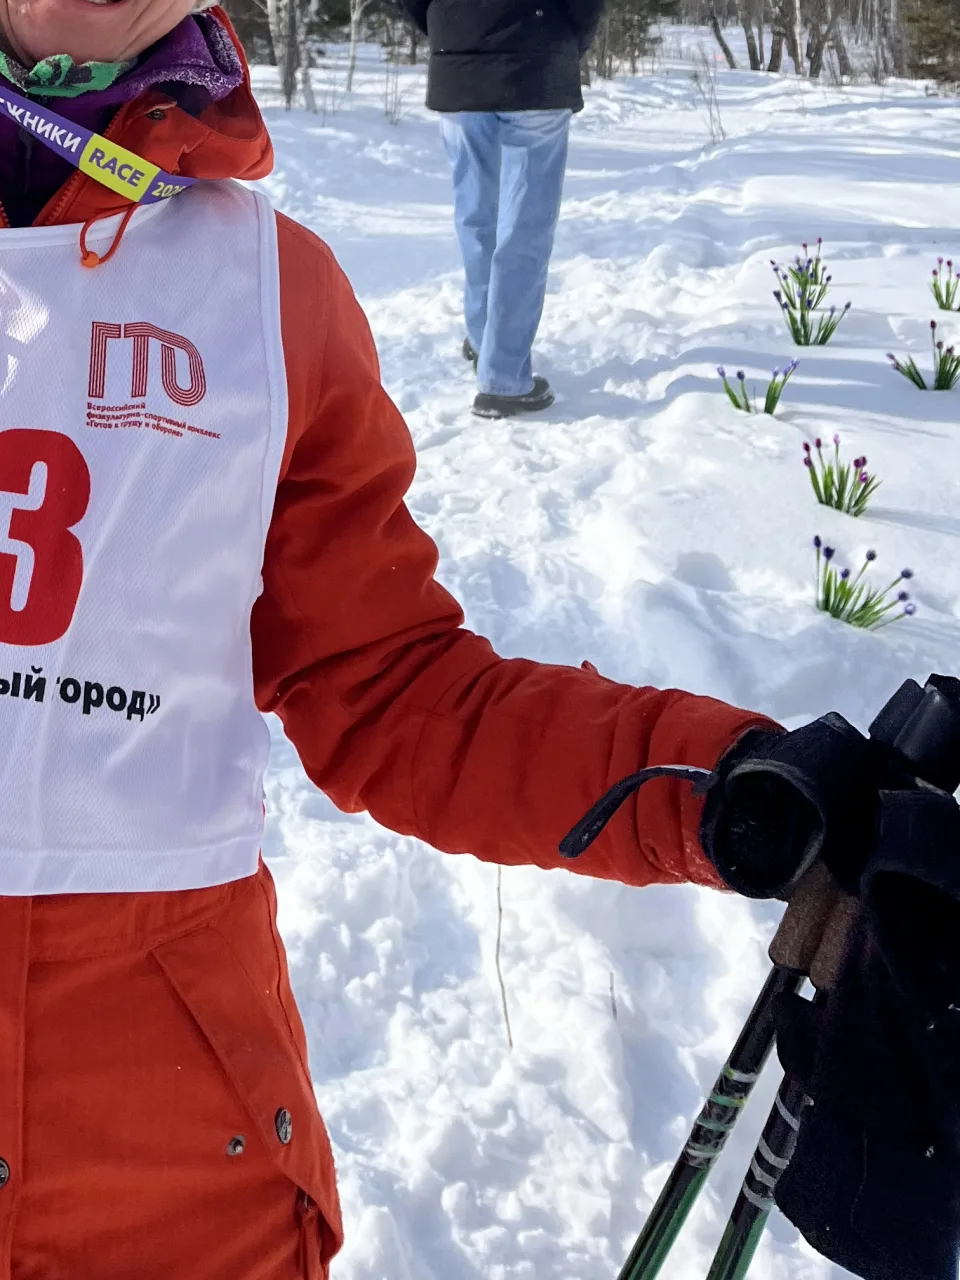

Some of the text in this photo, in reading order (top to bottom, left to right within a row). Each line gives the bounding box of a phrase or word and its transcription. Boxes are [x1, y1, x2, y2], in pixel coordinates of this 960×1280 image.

[88, 148, 145, 187] RACE
[88, 321, 207, 407] ГТО
[86, 411, 221, 439] физкультурно-спортивный комплекс
[87, 402, 146, 412] Всероссийский
[56, 676, 161, 721] ород»
